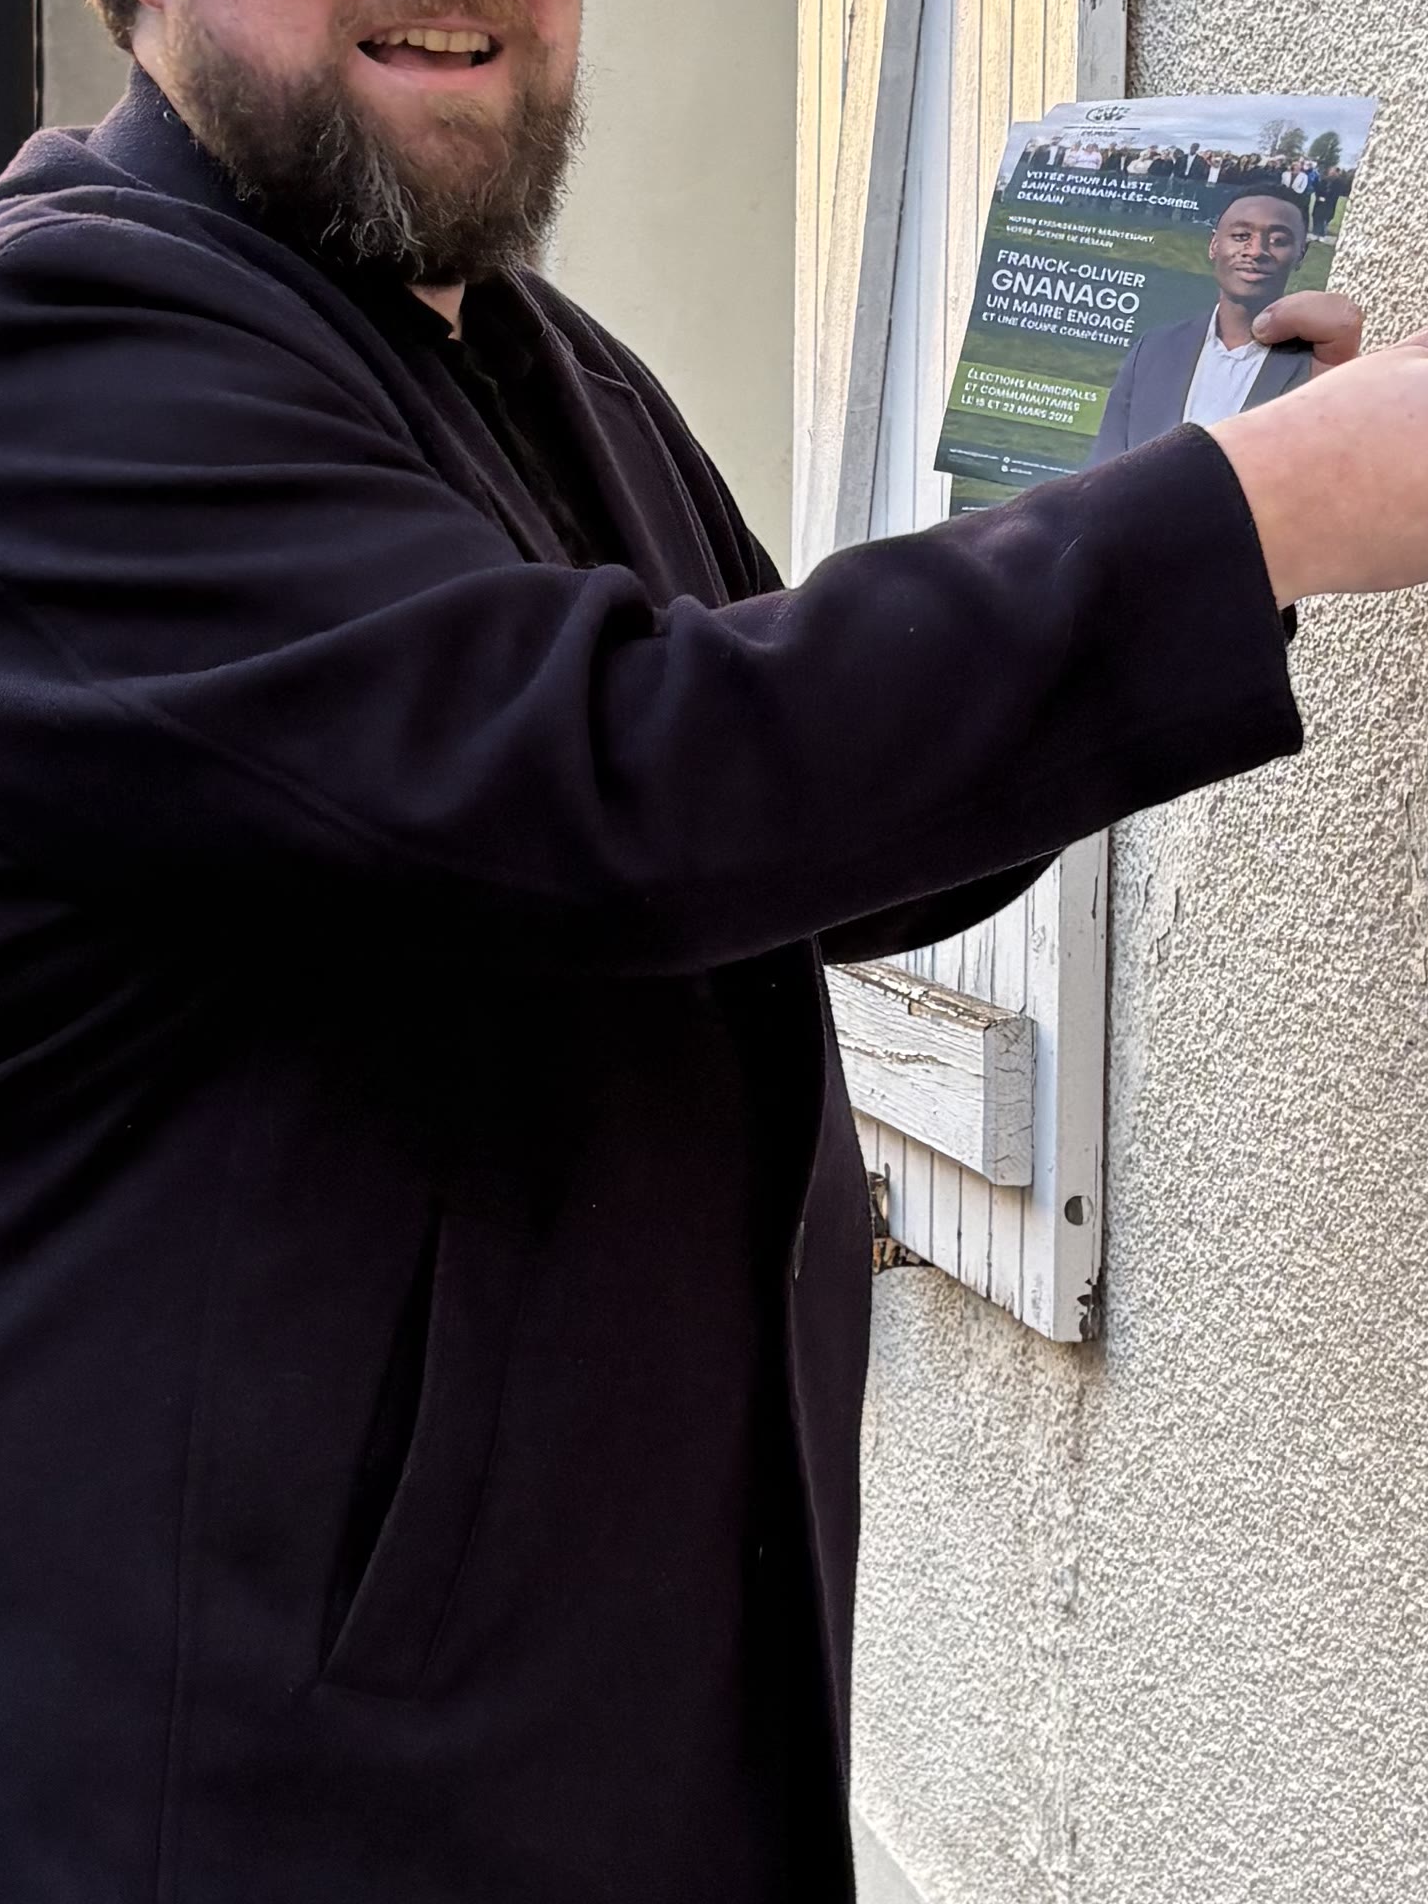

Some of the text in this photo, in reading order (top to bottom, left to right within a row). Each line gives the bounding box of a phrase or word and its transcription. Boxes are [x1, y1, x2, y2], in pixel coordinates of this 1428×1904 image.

[1066, 174, 1101, 185] POUR
[1120, 179, 1153, 192] LISTE
[1017, 191, 1065, 205] DEMAIN
[997, 249, 1146, 288] FRANCK-OLIVIER
[991, 269, 1140, 314] GNANAGO
[982, 311, 996, 322] ET
[986, 294, 1135, 334] UN MAIRE ENGAGÉ
[964, 382, 978, 393] ET
[1026, 380, 1098, 402] MUNICIPALES
[1016, 405, 1047, 419] MARS
